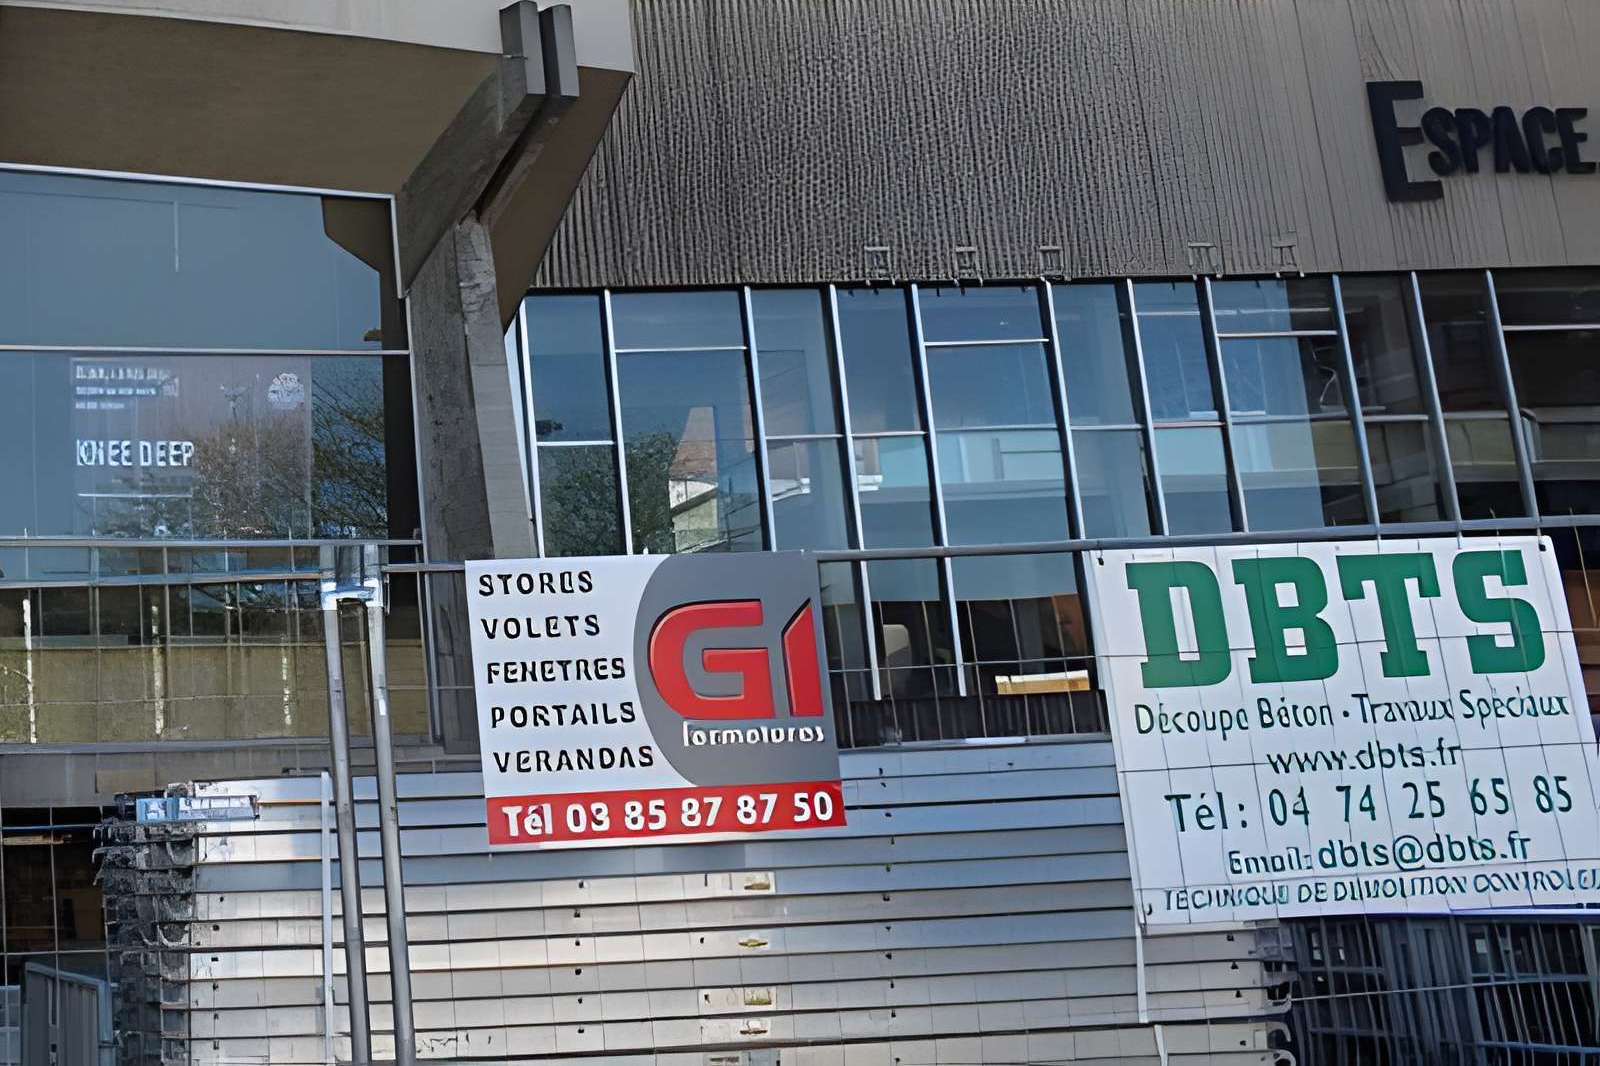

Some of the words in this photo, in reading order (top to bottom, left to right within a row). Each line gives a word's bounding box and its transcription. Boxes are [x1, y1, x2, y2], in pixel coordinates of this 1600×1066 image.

[1366, 80, 1597, 202] ESPACE
[139, 440, 195, 467] DEEP
[478, 570, 594, 596] STORES
[481, 614, 601, 640] VOLETS
[1125, 549, 1546, 689] DBTS
[487, 657, 626, 684] FENETRES
[491, 701, 636, 728] PORTAILS
[1134, 701, 1249, 741] Découpe
[1256, 696, 1335, 729] Béton
[1351, 692, 1455, 724] Travaux
[1459, 687, 1571, 730] Spéciaux
[493, 745, 655, 773] VERANDAS
[1267, 737, 1462, 774] www.dbts.fr
[502, 802, 553, 837] Tél
[566, 802, 611, 833] 03
[624, 799, 667, 830] 85
[680, 796, 723, 827] 87
[736, 793, 778, 824] 87
[793, 791, 833, 822] 50
[1268, 786, 1311, 827] 04
[1335, 783, 1378, 823] 74
[1402, 780, 1446, 820] 25
[1470, 777, 1511, 816] 65
[1532, 774, 1574, 814] 85
[1318, 830, 1532, 872] dbts@dbts.fr
[1298, 881, 1329, 903] DE
